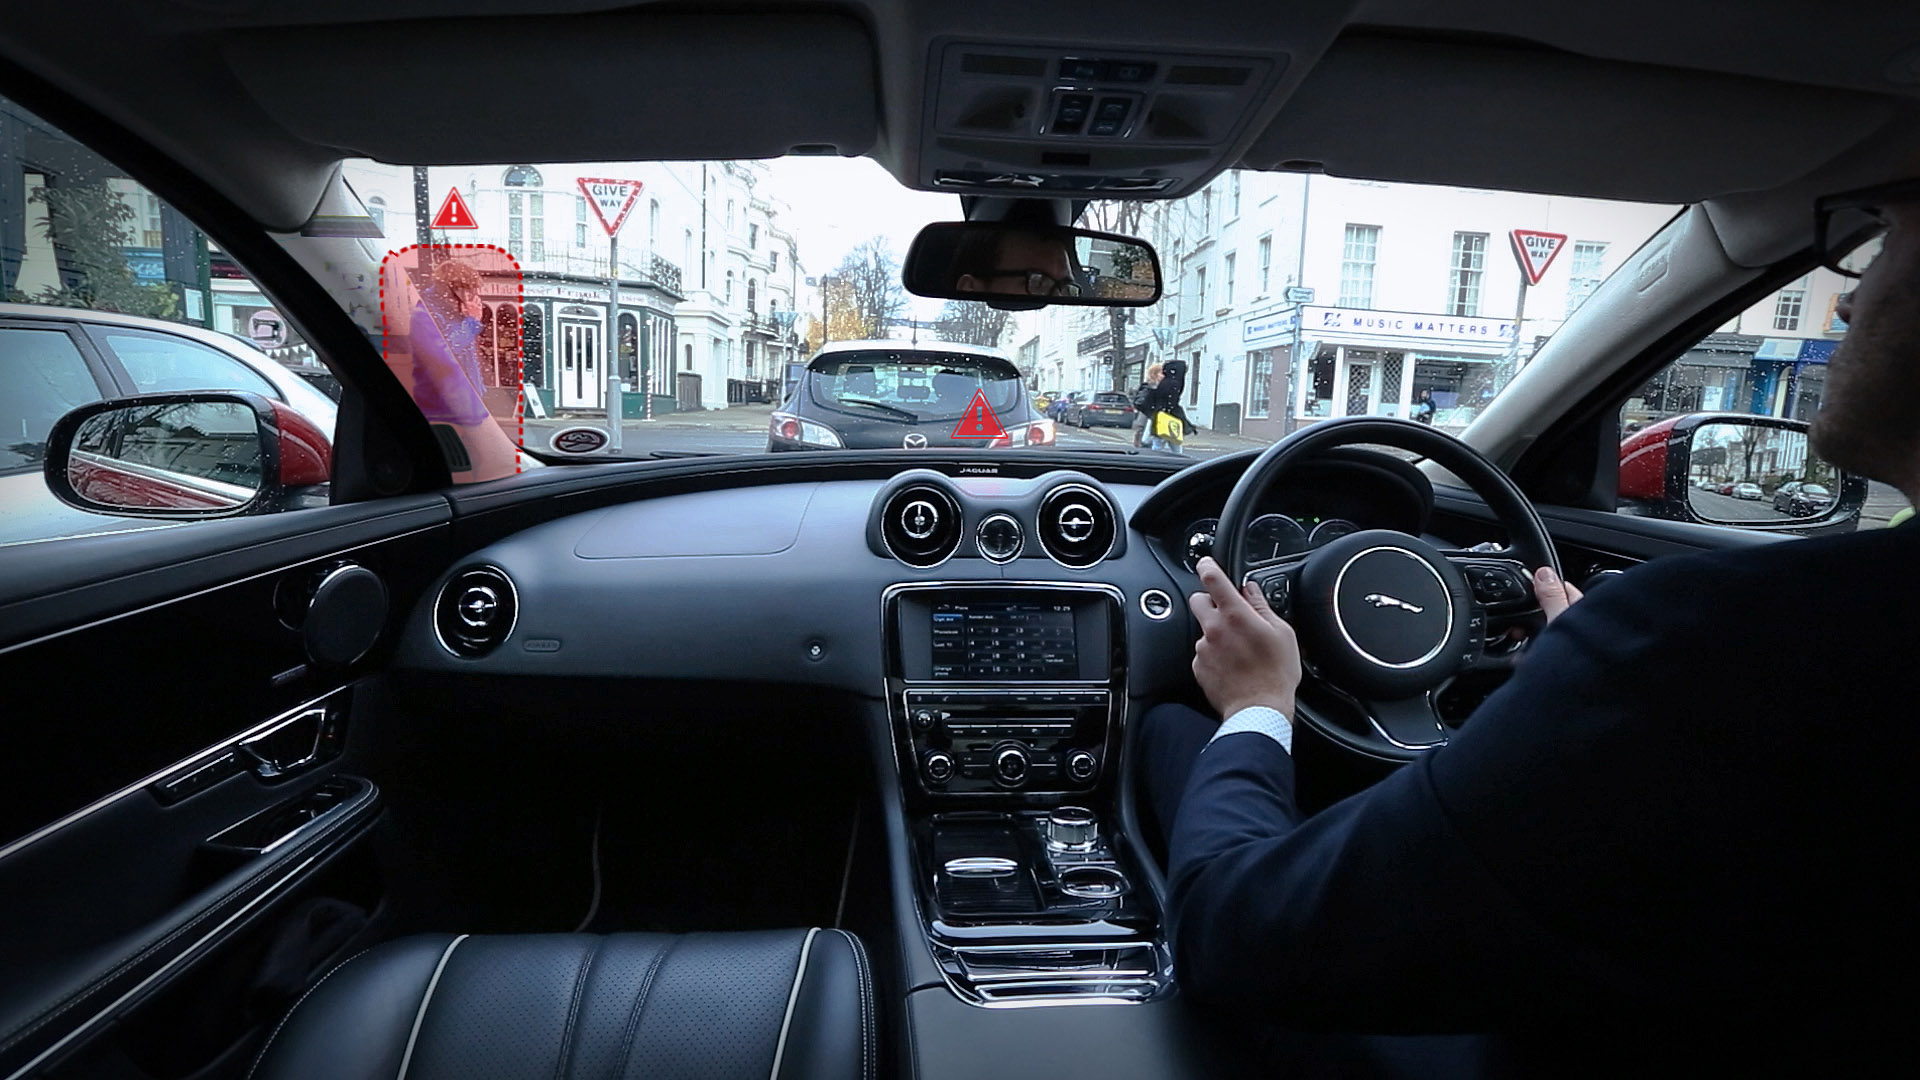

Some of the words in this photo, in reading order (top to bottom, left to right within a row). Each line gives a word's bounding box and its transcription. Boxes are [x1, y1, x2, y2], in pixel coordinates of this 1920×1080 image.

[592, 184, 628, 197] GIVE
[600, 199, 621, 208] WAY
[1525, 236, 1556, 249] GIVE
[1531, 250, 1549, 258] WAY
[1353, 317, 1403, 330] MUSIC
[1414, 321, 1488, 335] MATTERS
